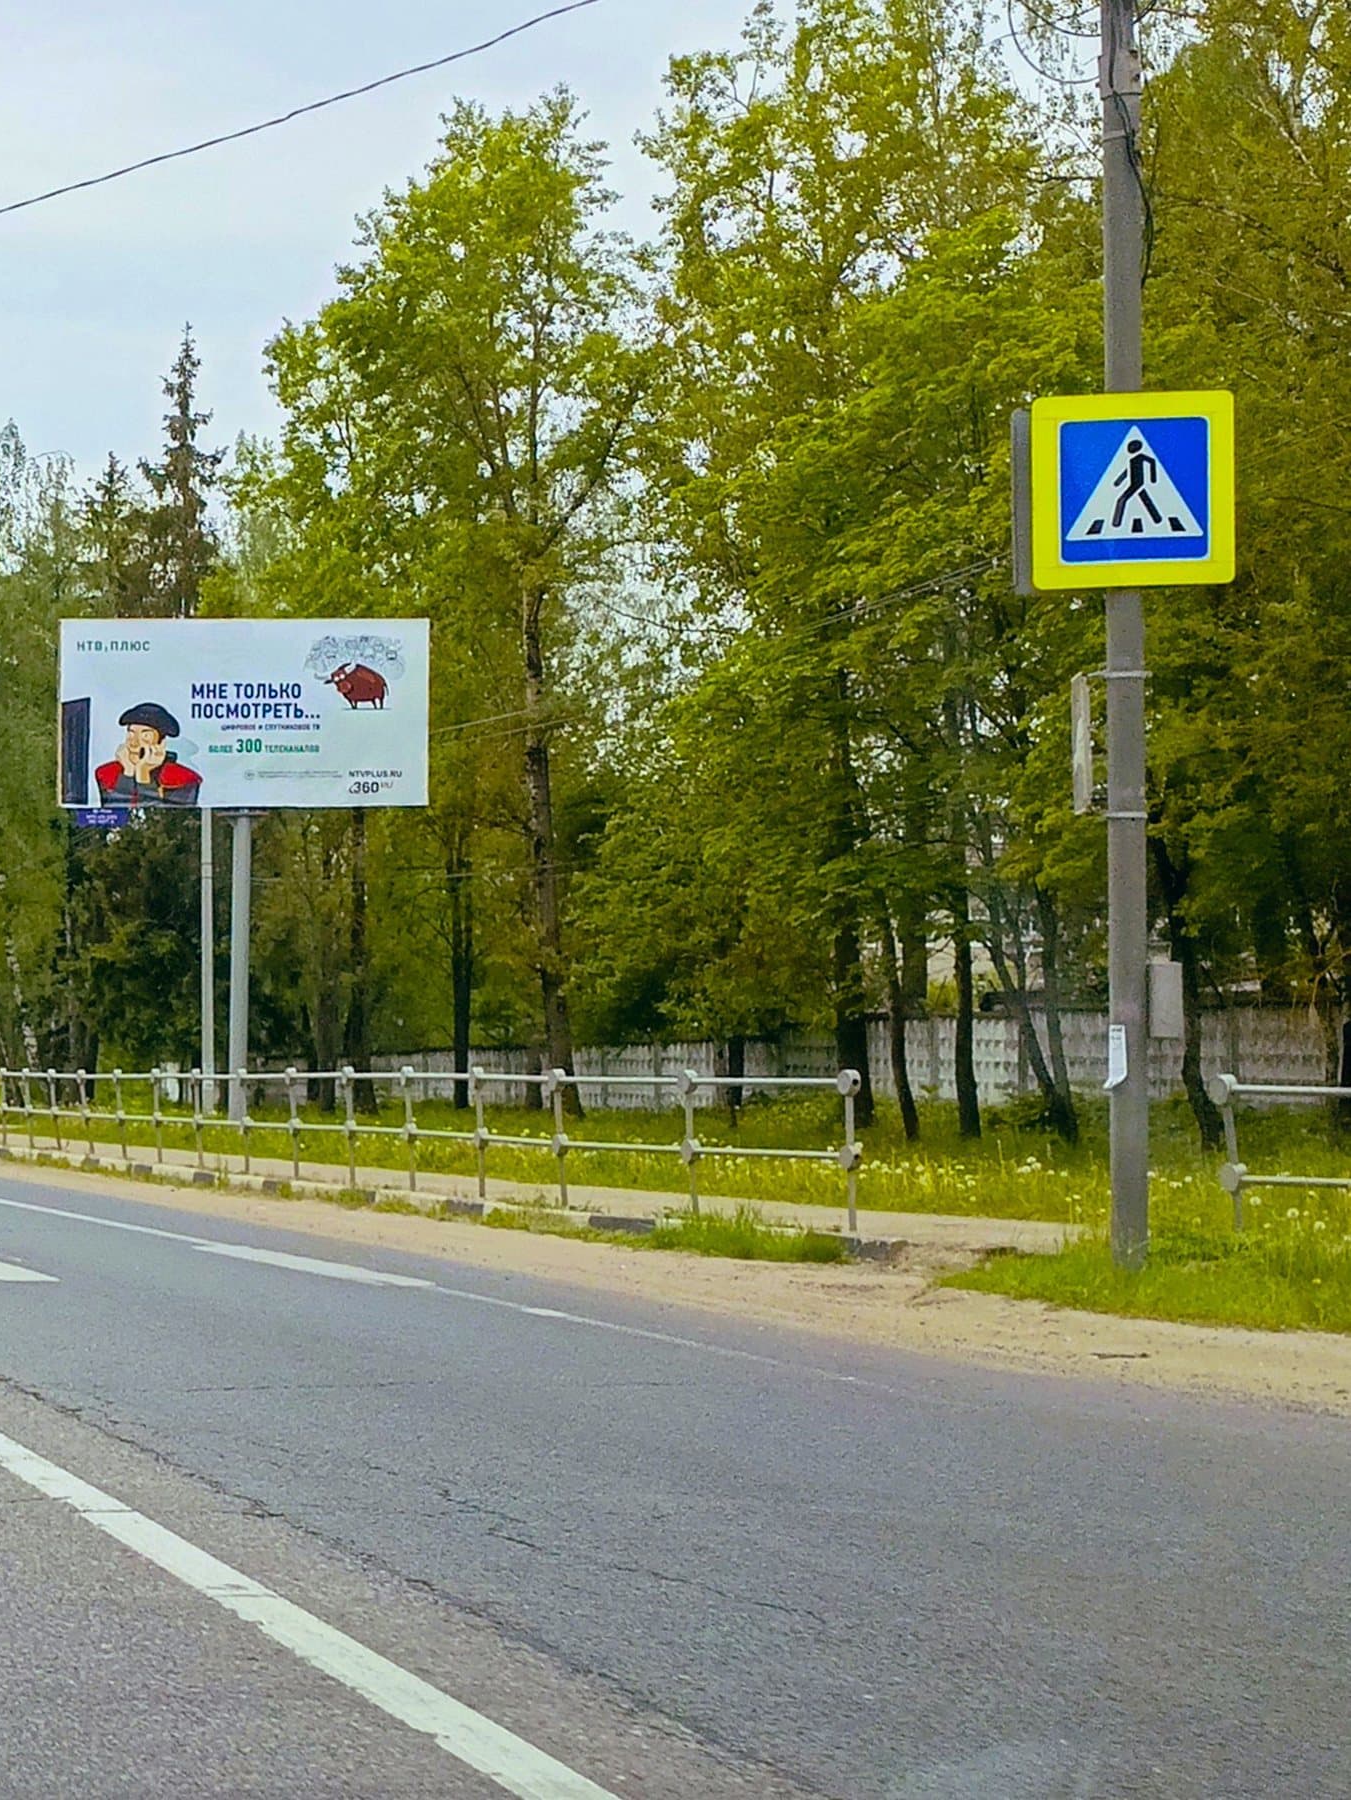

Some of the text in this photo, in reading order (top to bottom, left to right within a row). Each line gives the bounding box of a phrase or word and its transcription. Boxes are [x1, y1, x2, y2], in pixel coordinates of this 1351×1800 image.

[191, 683, 302, 699] МНЕ ТОЛЬКО
[191, 703, 321, 719] ПОСМОТРЕТЬ...
[236, 739, 262, 753] 300
